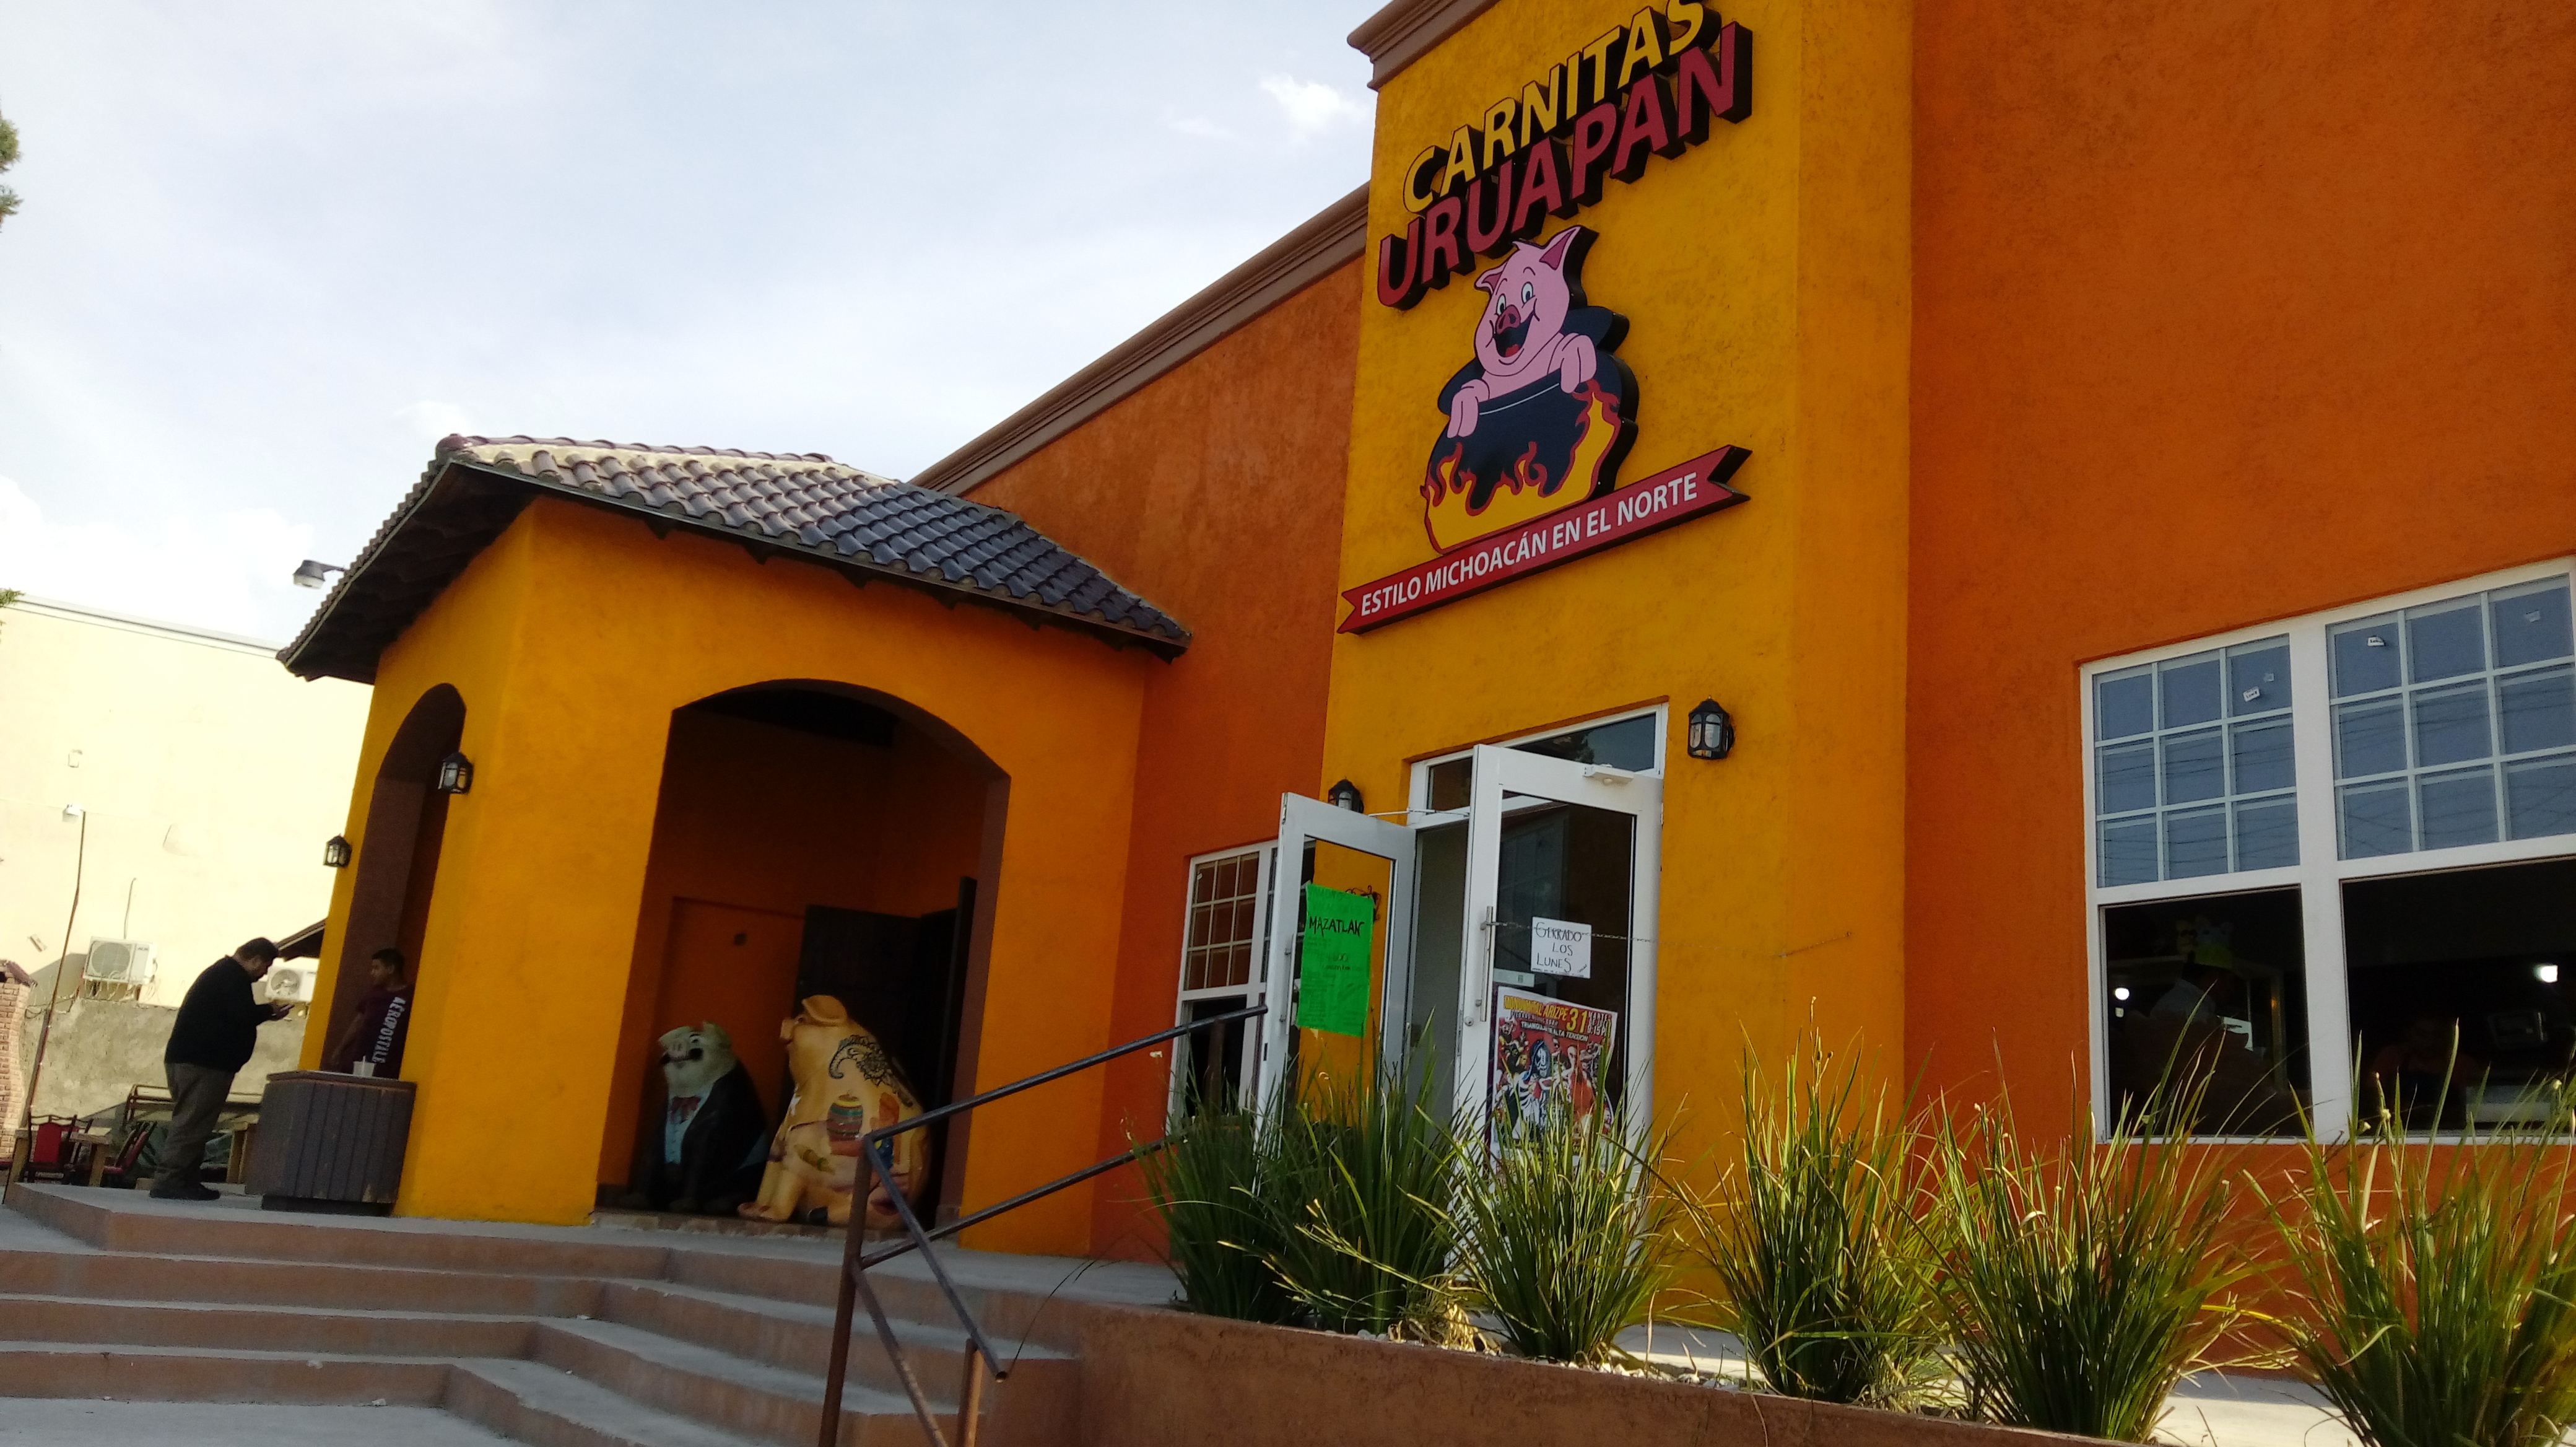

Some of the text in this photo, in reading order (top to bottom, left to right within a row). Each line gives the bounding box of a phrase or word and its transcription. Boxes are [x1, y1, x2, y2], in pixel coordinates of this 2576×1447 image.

[1402, 0, 1705, 214] CARNITAS
[1377, 21, 1738, 307] URUAPAN
[1360, 472, 1697, 617] ESTILO MICHOACÁN EN EL NORTE
[1536, 952, 1572, 973] LUNES
[1552, 942, 1573, 956] LOS
[1543, 1003, 1569, 1021] ARIZPE
[1566, 1008, 1588, 1033] 31
